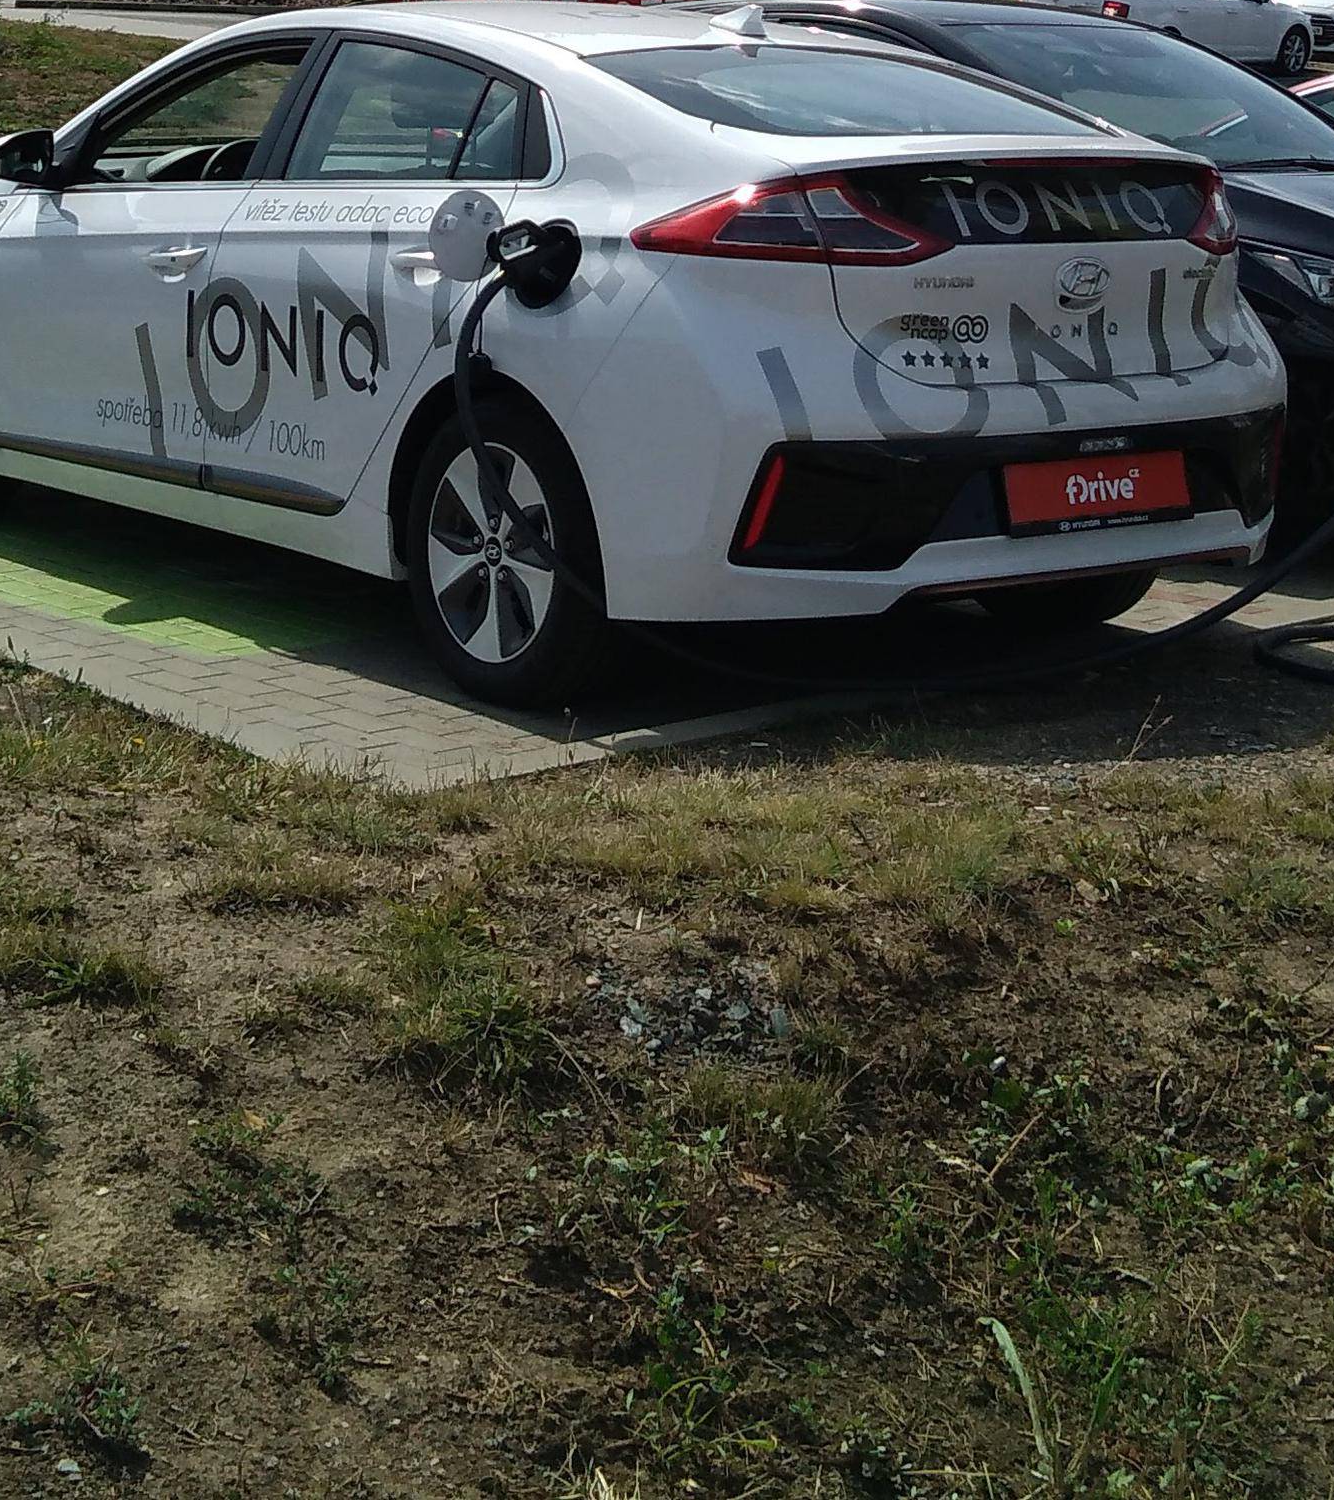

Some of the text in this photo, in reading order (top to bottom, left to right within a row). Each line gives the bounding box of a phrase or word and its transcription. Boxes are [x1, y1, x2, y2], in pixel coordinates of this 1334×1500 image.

[288, 200, 335, 223] testu
[336, 194, 391, 223] adac
[938, 180, 1172, 236] IONIQ
[186, 289, 379, 396] IONIQ
[900, 312, 949, 334] green
[910, 323, 948, 343] ncap
[96, 396, 163, 430] spotřeba
[268, 420, 326, 461] 100km
